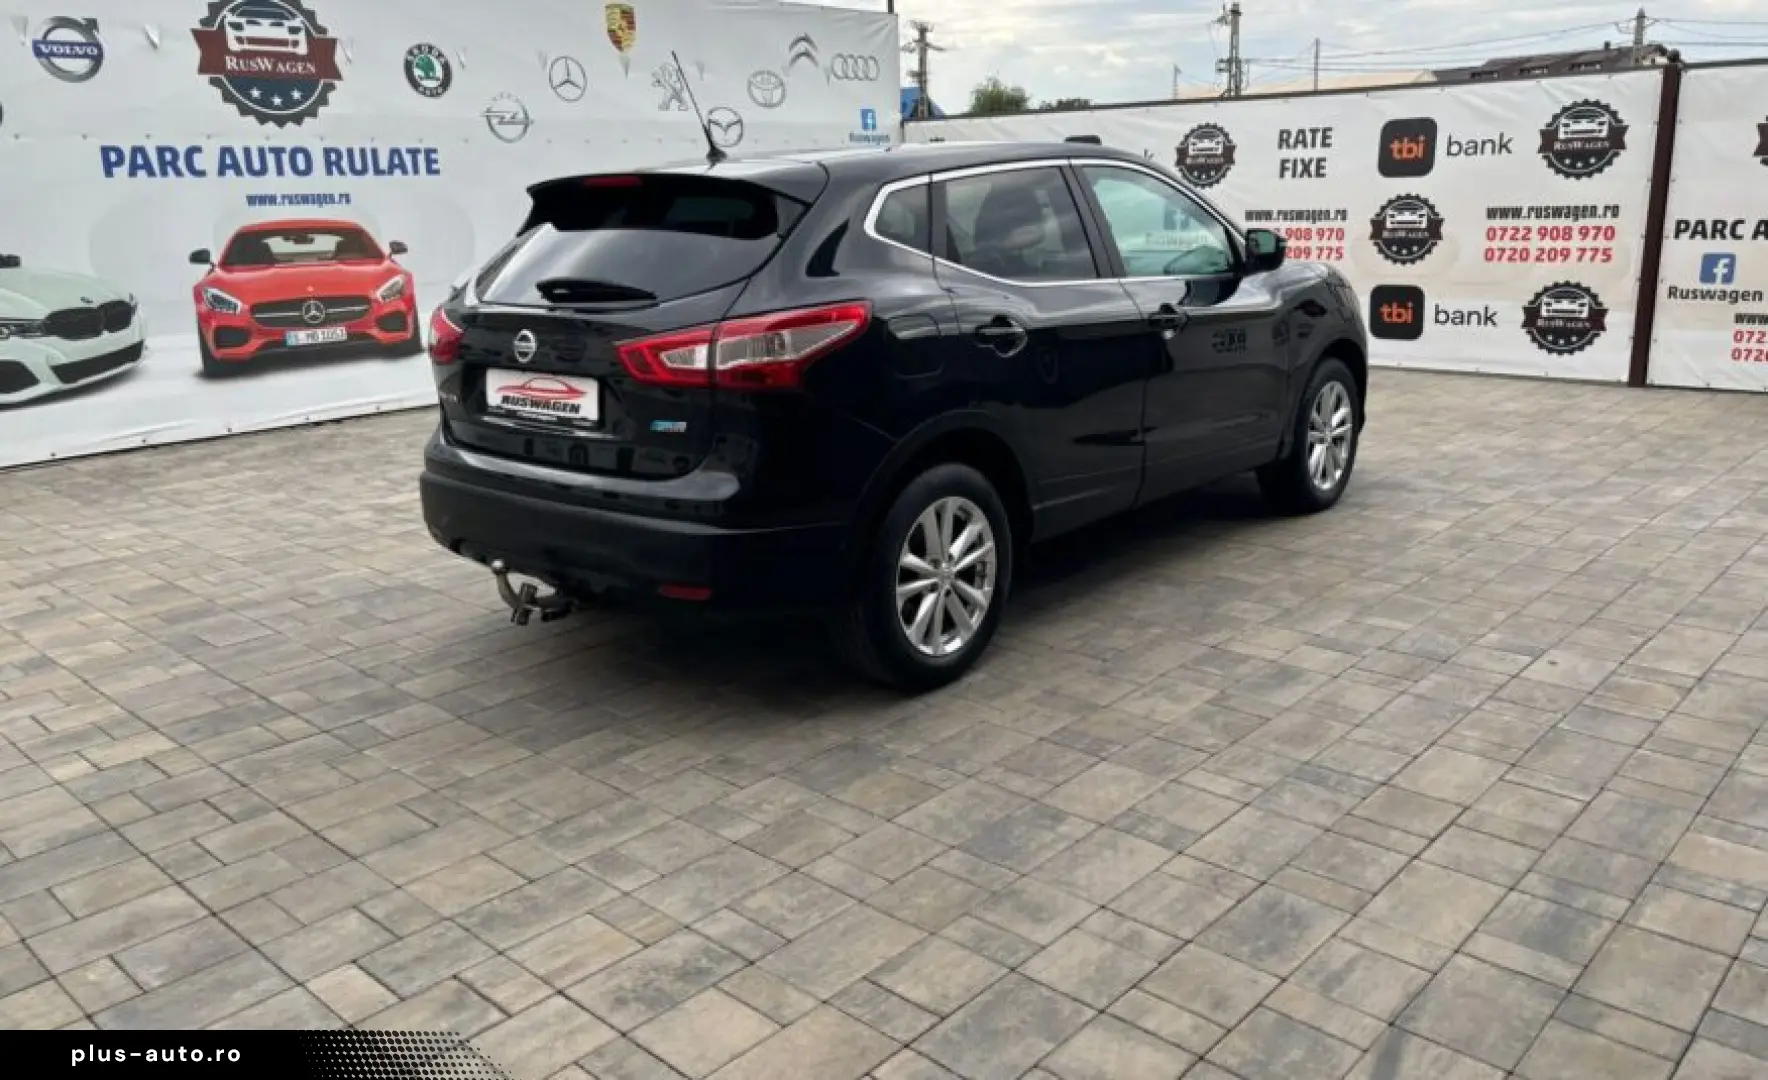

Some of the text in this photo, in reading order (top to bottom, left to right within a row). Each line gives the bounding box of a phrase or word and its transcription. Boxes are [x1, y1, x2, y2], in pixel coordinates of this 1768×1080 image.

[36, 44, 98, 55] VOLVO
[1278, 127, 1332, 149] RATE
[1390, 131, 1514, 160] tbi bank
[100, 144, 440, 178] PARC AUTO RULATE
[1280, 157, 1326, 179] FIXE
[246, 193, 351, 208] www.ruswagen.ro
[1245, 209, 1347, 224] www.ruswagen.ro
[1486, 204, 1620, 222] www.ruswagen.ro
[1285, 228, 1312, 240] 908
[1316, 228, 1344, 240] 970
[1486, 225, 1616, 241] 0722 908 970
[1674, 219, 1745, 240] PARC
[1316, 246, 1344, 260] 775
[1484, 247, 1613, 262] 0720 209 775
[1667, 286, 1763, 304] Ruswagen
[1380, 301, 1497, 327] tbi bank
[1733, 330, 1768, 344] 072
